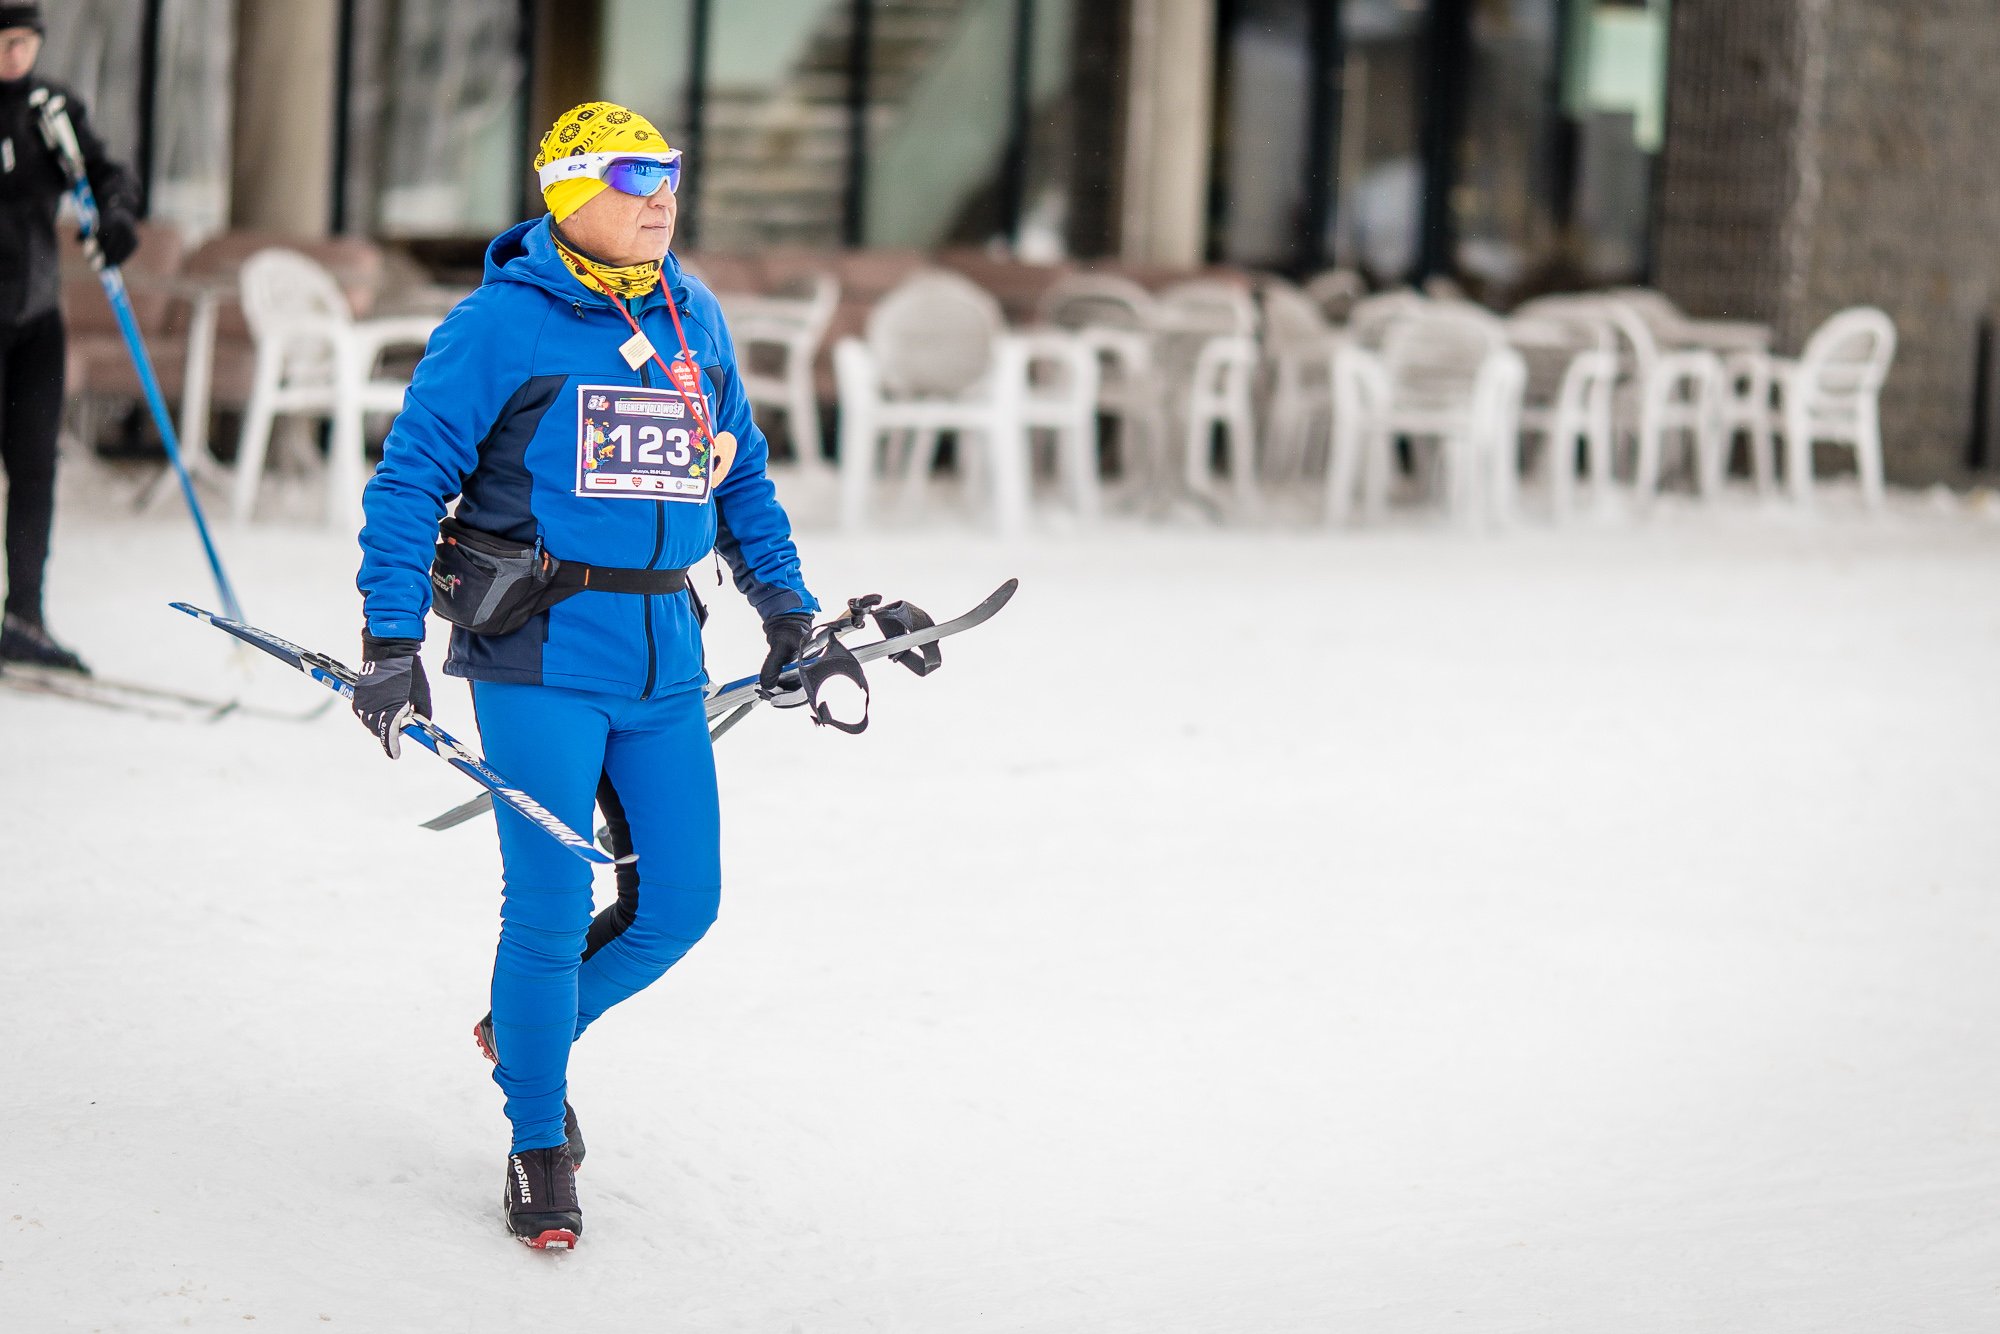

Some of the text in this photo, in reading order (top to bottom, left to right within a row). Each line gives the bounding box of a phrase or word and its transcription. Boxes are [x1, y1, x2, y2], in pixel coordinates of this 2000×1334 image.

[649, 404, 661, 413] DLA
[662, 402, 683, 415] WOŚP
[608, 424, 691, 467] 123
[496, 787, 595, 850] NORDWAY
